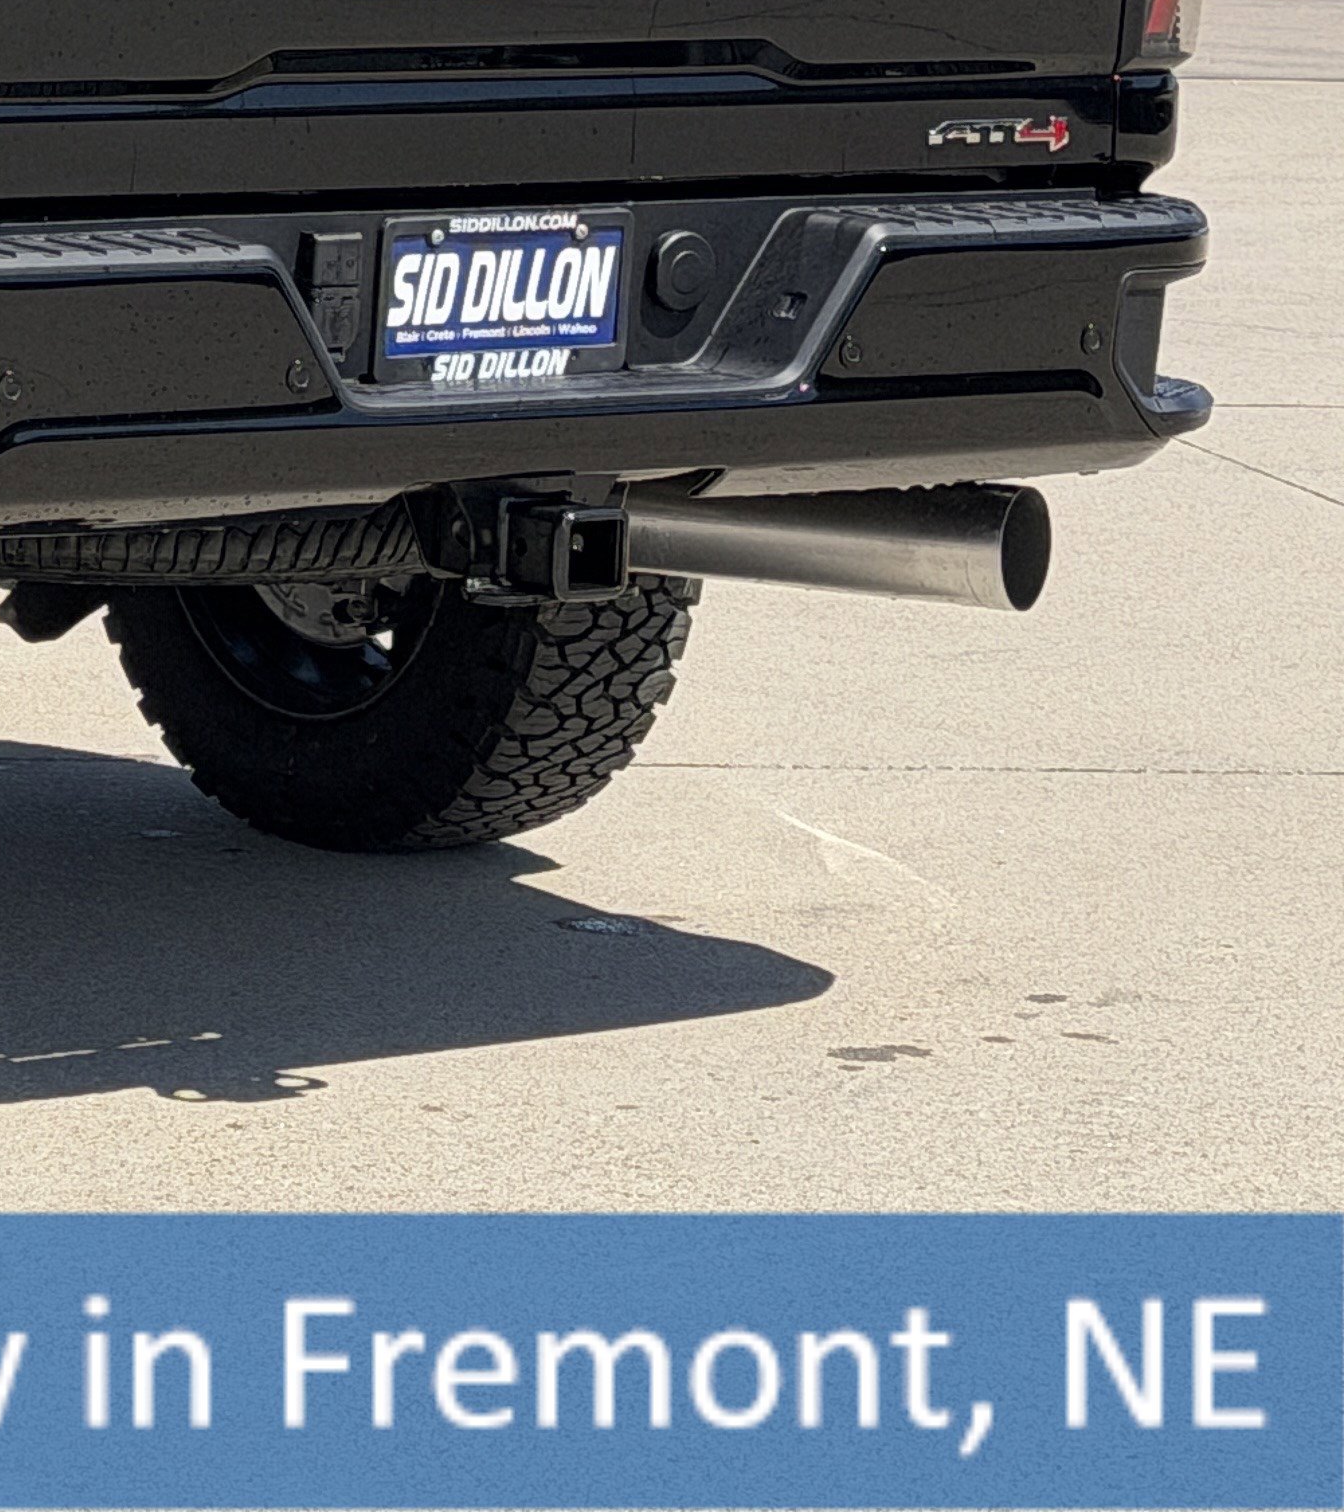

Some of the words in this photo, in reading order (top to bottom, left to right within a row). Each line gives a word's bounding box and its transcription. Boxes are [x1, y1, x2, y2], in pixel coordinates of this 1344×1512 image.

[928, 115, 1069, 152] AT4
[448, 214, 578, 234] SIDDILLON.COM
[386, 252, 461, 328] SID
[460, 245, 617, 323] DILLON
[462, 326, 506, 339] Fremont
[557, 322, 598, 335] Wahoo
[430, 352, 476, 382] SID
[477, 348, 571, 380] DILLON
